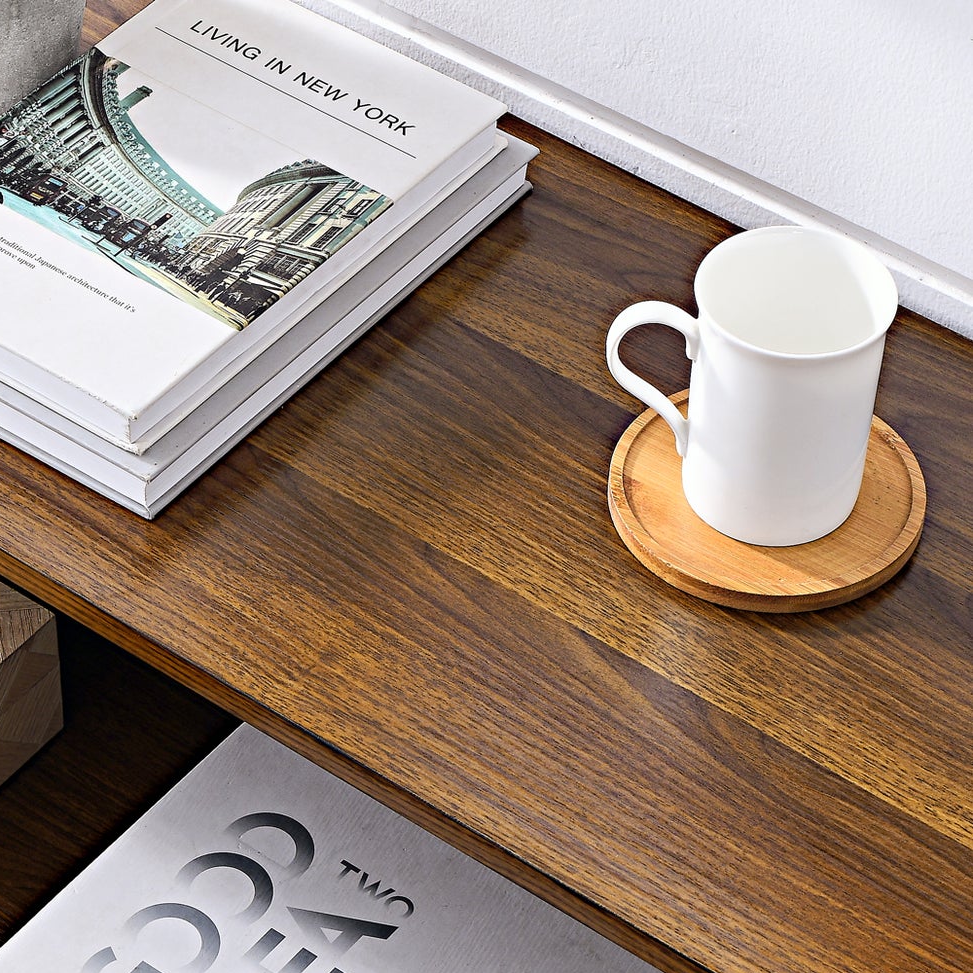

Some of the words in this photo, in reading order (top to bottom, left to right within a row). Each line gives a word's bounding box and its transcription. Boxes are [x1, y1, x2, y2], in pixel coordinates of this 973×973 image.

[190, 20, 261, 60] LIVING
[264, 57, 291, 75] IN
[293, 72, 348, 101] NEW
[353, 99, 416, 136] YORK
[0, 236, 36, 259] traditional
[34, 256, 67, 276] Japanese
[67, 273, 109, 298] architecture
[109, 296, 125, 307] that
[17, 257, 36, 270] upon
[336, 859, 414, 919] TWO
